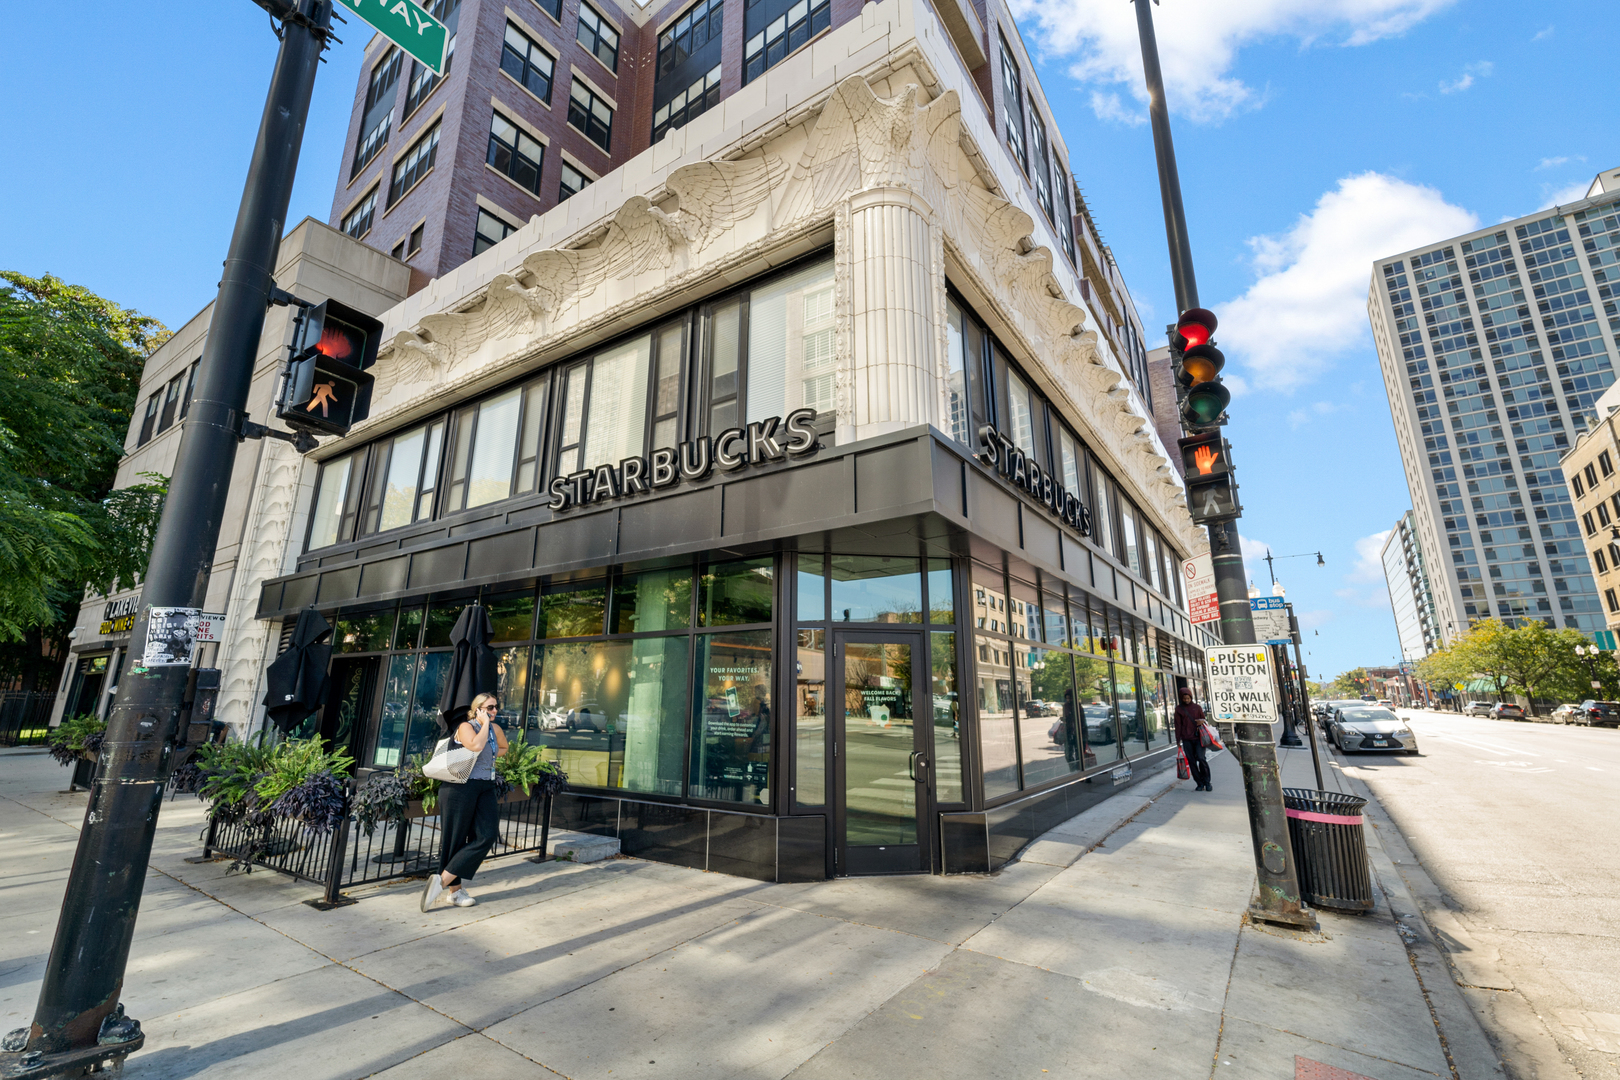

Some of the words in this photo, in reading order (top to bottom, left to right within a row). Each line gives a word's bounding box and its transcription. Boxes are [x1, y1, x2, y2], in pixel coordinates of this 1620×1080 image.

[548, 408, 819, 511] STARBUCKS
[979, 422, 1092, 537] STARBUCKS
[113, 617, 128, 632] WINE
[1218, 653, 1256, 664] PUSH
[1211, 664, 1266, 676] BUTTON
[1214, 692, 1236, 701] FOR
[1239, 692, 1271, 702] WALK
[1220, 702, 1266, 713] SIGNAL
